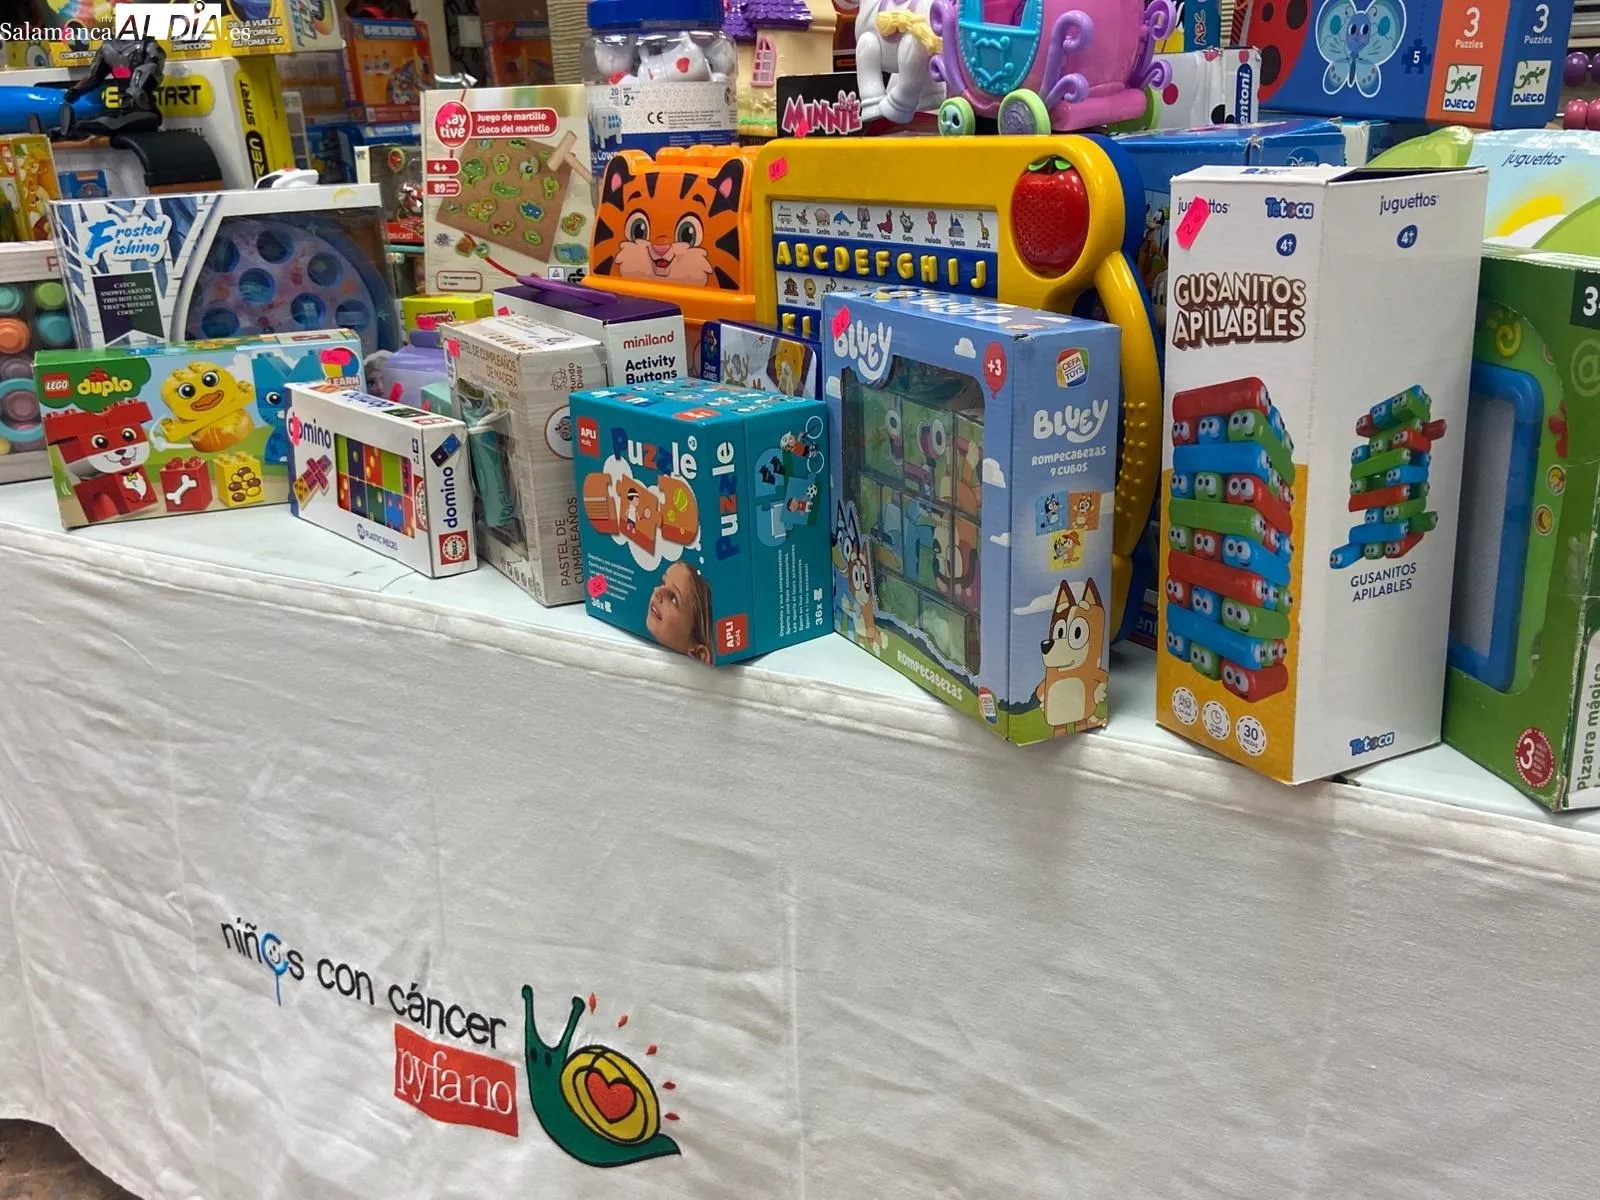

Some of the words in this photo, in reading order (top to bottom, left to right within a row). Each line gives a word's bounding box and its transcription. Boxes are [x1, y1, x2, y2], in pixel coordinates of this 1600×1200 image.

[1463, 7, 1480, 38] 3
[1532, 4, 1549, 33] 3
[1455, 39, 1484, 49] Puzzles
[1523, 35, 1553, 44] Puzzles
[1413, 50, 1420, 64] 5
[1444, 98, 1475, 110] DJECO
[1513, 93, 1544, 103] DJECO
[477, 114, 500, 122] Juego
[502, 113, 512, 121] de
[514, 112, 546, 121] martillo
[782, 91, 862, 135] MINNIE
[440, 127, 466, 138] tive
[477, 125, 500, 134] Gioco
[501, 125, 514, 133] del
[515, 124, 550, 132] martello
[434, 162, 448, 172] 4+
[1502, 150, 1565, 168] juguettos
[434, 184, 446, 193] 89
[1379, 192, 1440, 216] juguettos
[776, 241, 792, 266] A
[795, 243, 810, 267] B
[813, 244, 829, 270] C
[834, 246, 850, 272] D
[854, 248, 870, 275] E
[875, 250, 890, 277] F
[896, 252, 914, 279] G
[920, 255, 938, 283] H
[947, 258, 958, 286] I
[970, 260, 987, 289] J
[1174, 272, 1307, 312] GUSANITOS
[1172, 307, 1306, 351] APILABLES
[623, 331, 674, 349] miniland
[835, 319, 892, 381] BLUEY
[625, 355, 676, 372] Activity
[987, 359, 1002, 376] +3
[1062, 356, 1081, 371] CEFA
[1065, 366, 1084, 381] TOYS
[46, 381, 68, 390] LEGO
[77, 376, 133, 397] duplo
[328, 376, 360, 386] LEARN
[626, 369, 678, 385] Buttons
[1033, 400, 1109, 443] BLUEY
[580, 427, 597, 440] APLI
[611, 427, 698, 480] Puzzle
[1058, 462, 1088, 476] CUBOS
[441, 467, 458, 528] domino
[712, 441, 740, 562] Puzzle
[555, 520, 566, 536] DE
[567, 496, 584, 584] CUMPLEAÑOS
[558, 540, 571, 587] PASTEL
[1350, 562, 1417, 588] GUSANITOS
[1352, 578, 1413, 603] APILABLES
[815, 603, 823, 627] 36x
[726, 621, 735, 648] APLI
[1244, 724, 1258, 741] 30
[1520, 737, 1535, 770] 3
[1577, 731, 1597, 790] Pizarra
[220, 917, 305, 981] niños
[317, 958, 375, 1005] con
[388, 982, 507, 1049] cáncer
[396, 1048, 513, 1115] pyfano
